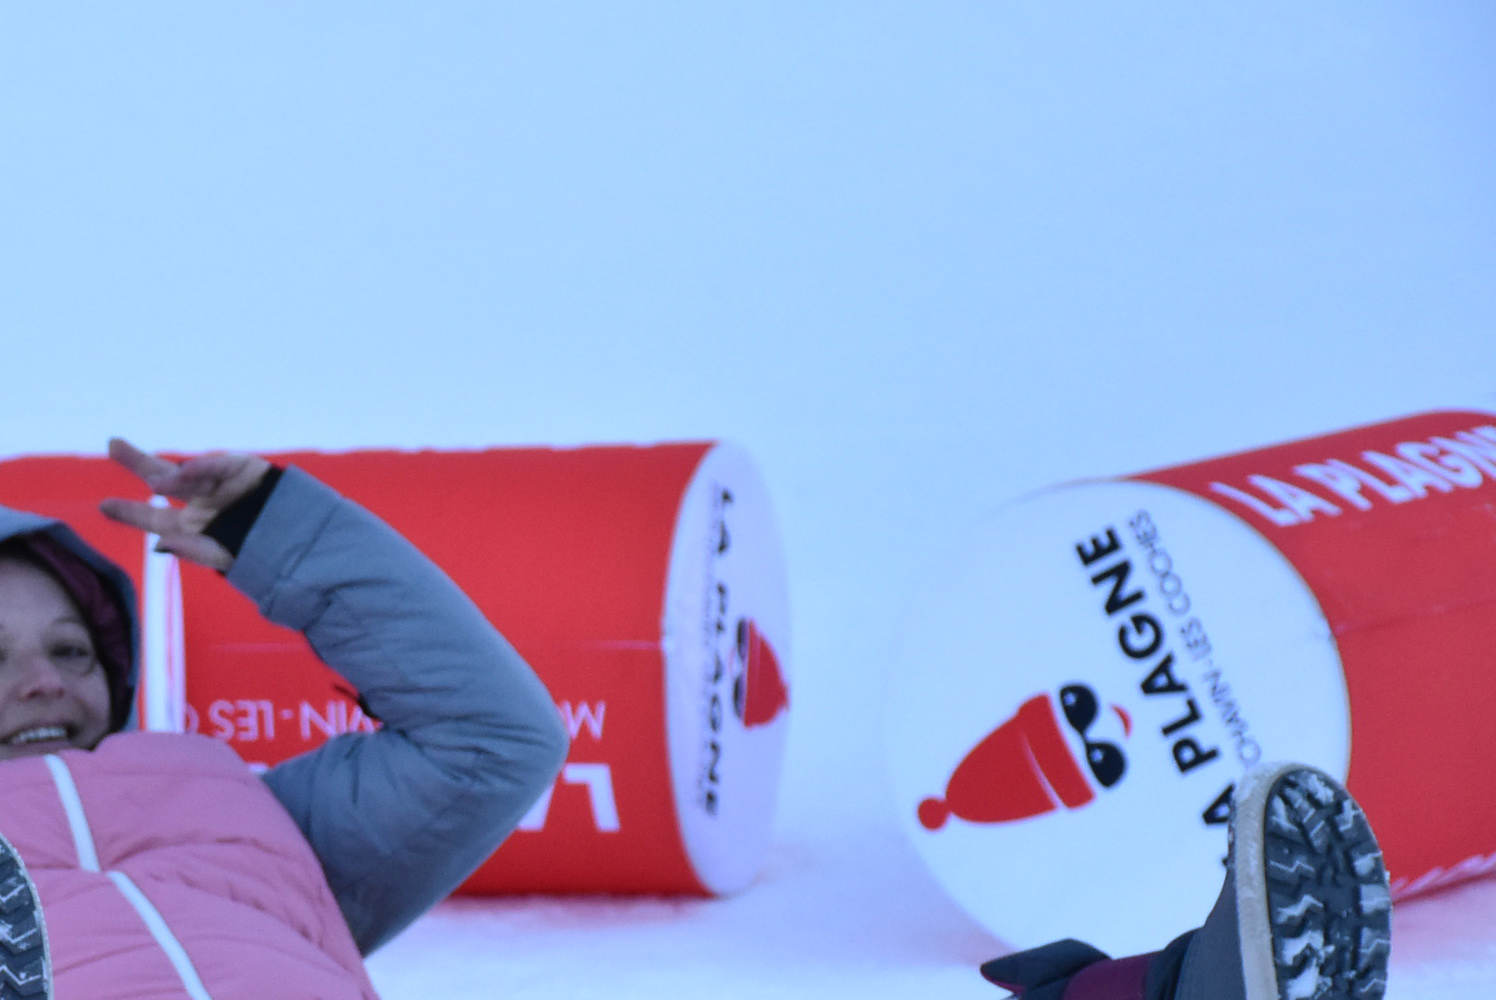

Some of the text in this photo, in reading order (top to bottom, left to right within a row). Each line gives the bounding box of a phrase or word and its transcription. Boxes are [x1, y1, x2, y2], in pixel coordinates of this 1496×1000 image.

[1208, 424, 1496, 527] LA PLAGN
[1075, 527, 1220, 775] PLAGNE
